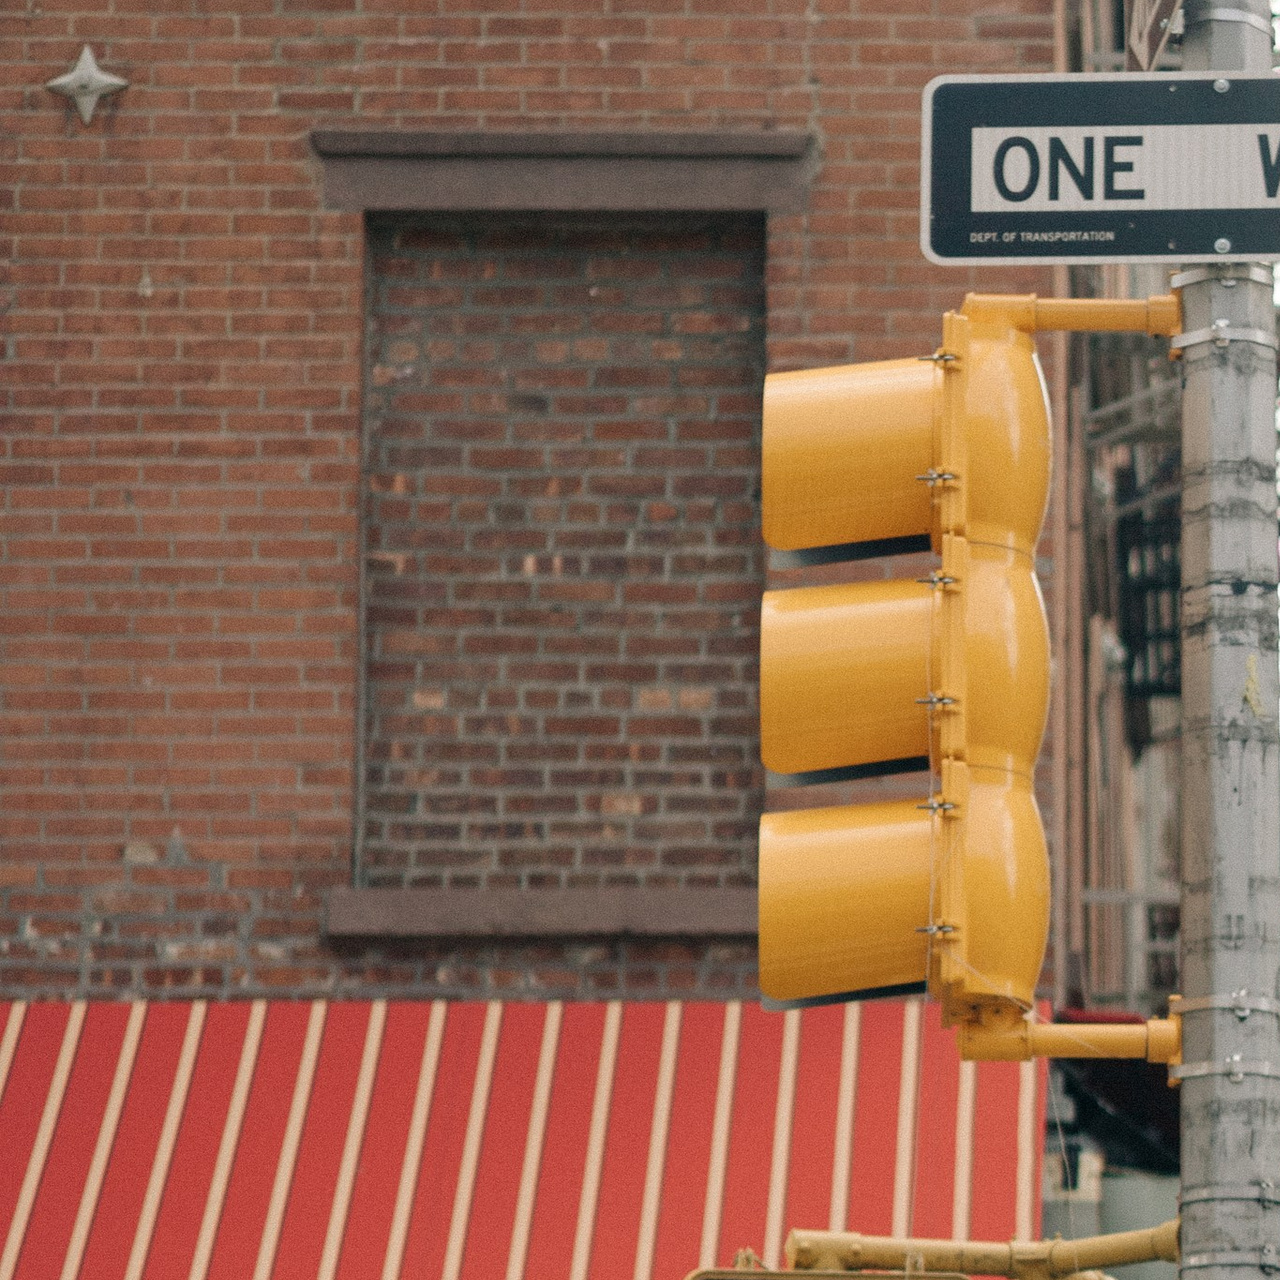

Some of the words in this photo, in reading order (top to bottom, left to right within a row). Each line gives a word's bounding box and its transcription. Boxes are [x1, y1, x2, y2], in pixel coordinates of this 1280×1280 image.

[993, 135, 1145, 202] ONE
[969, 231, 999, 243] DEPT.
[1002, 231, 1017, 242] OF
[1020, 231, 1115, 242] TRANSPORTATION
